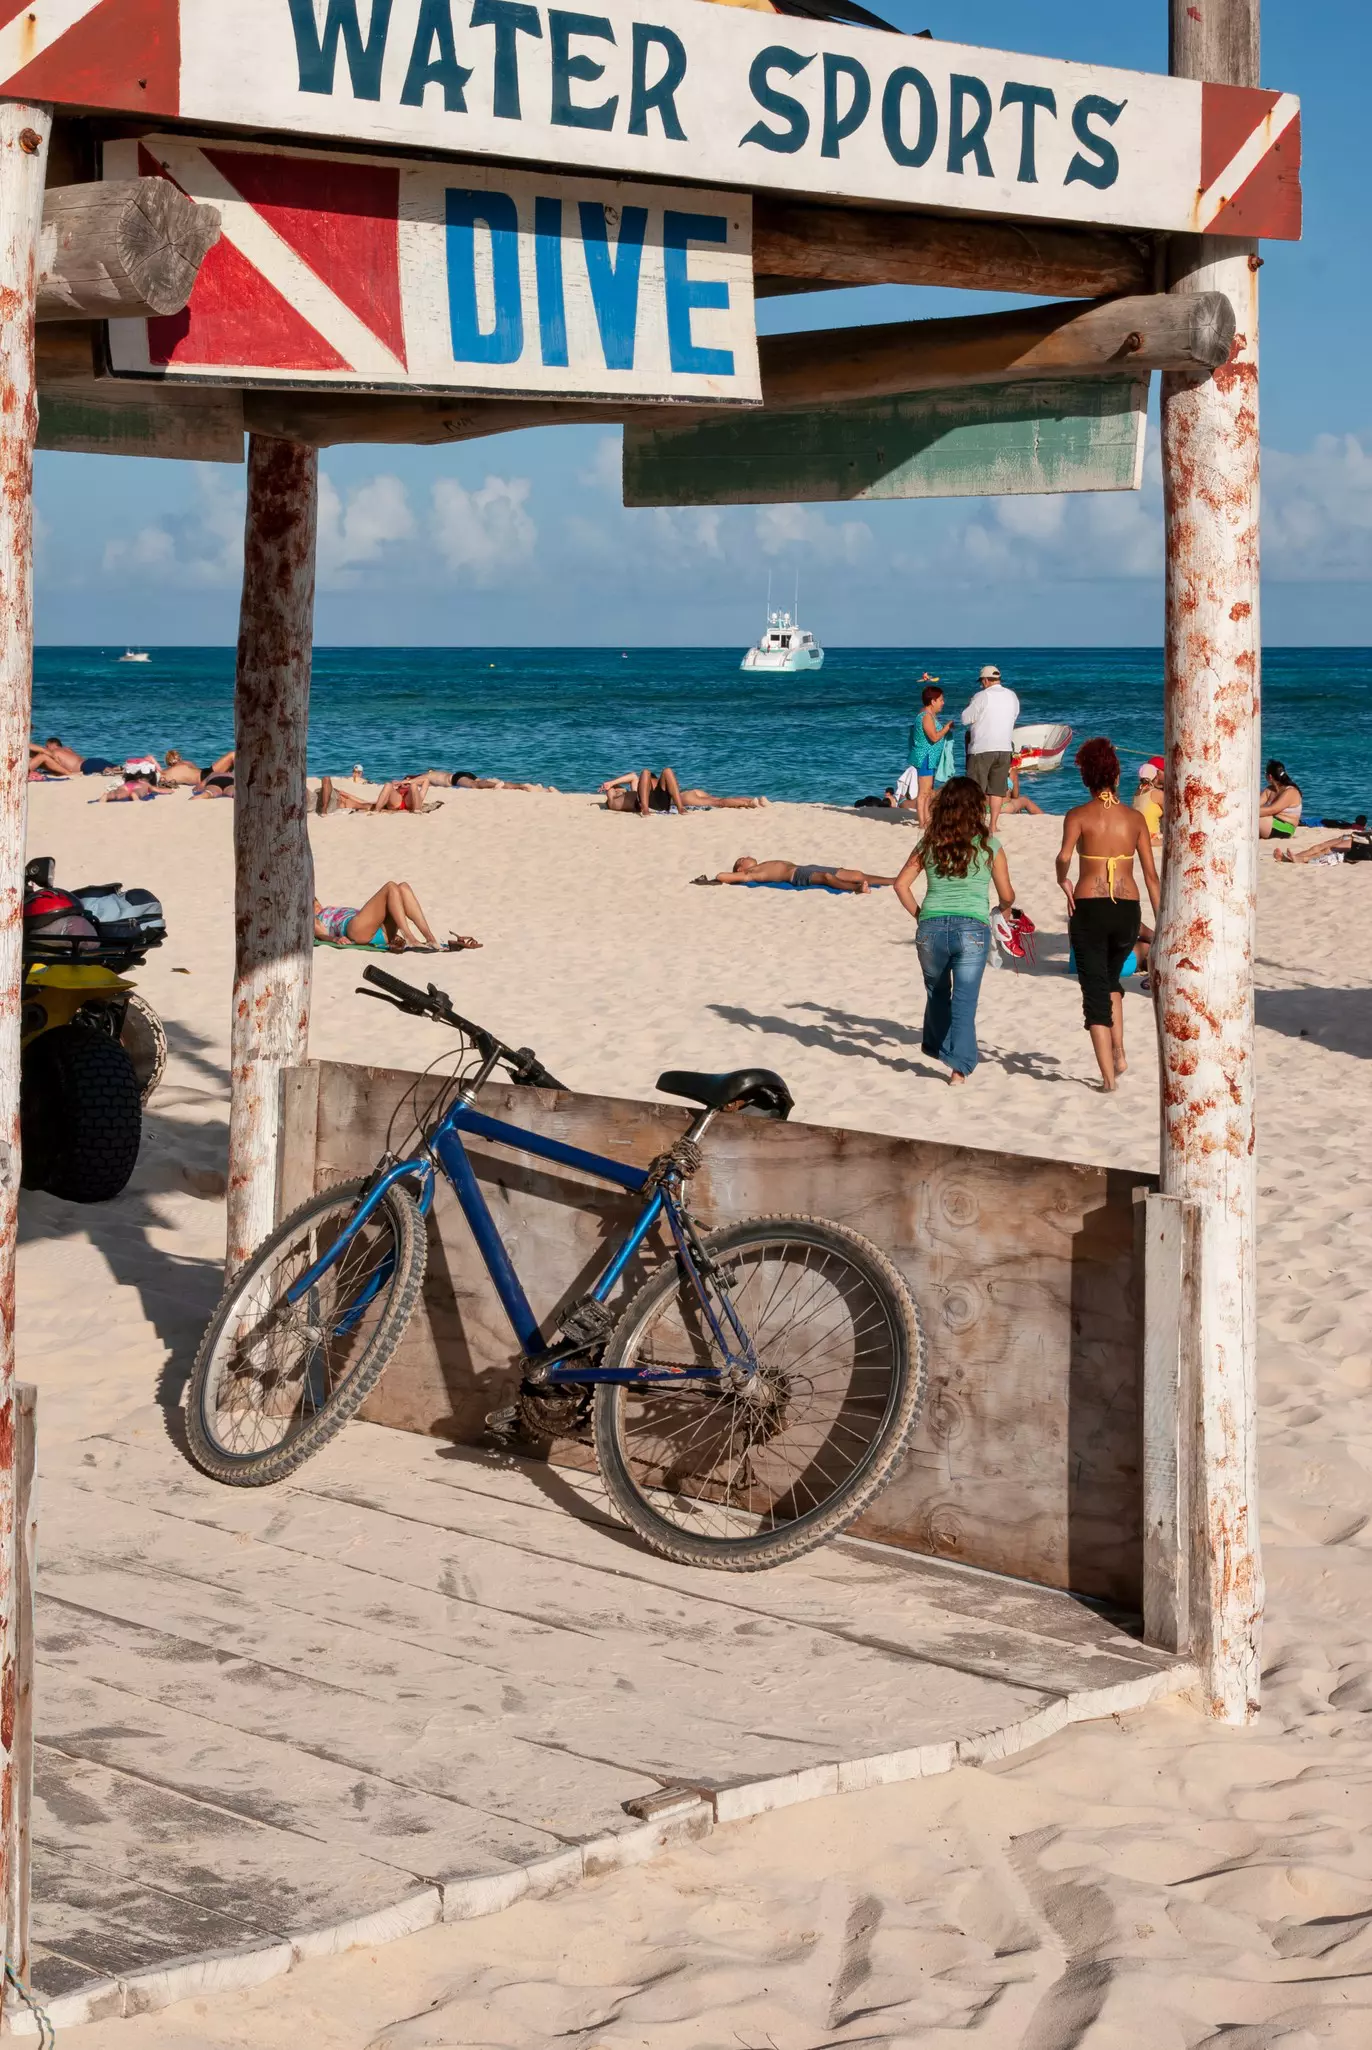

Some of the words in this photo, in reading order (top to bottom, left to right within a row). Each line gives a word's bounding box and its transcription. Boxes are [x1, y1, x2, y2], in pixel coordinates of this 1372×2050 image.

[289, 0, 688, 141] WATER
[738, 45, 1128, 190] SPORTS
[445, 188, 735, 376] DIVE
